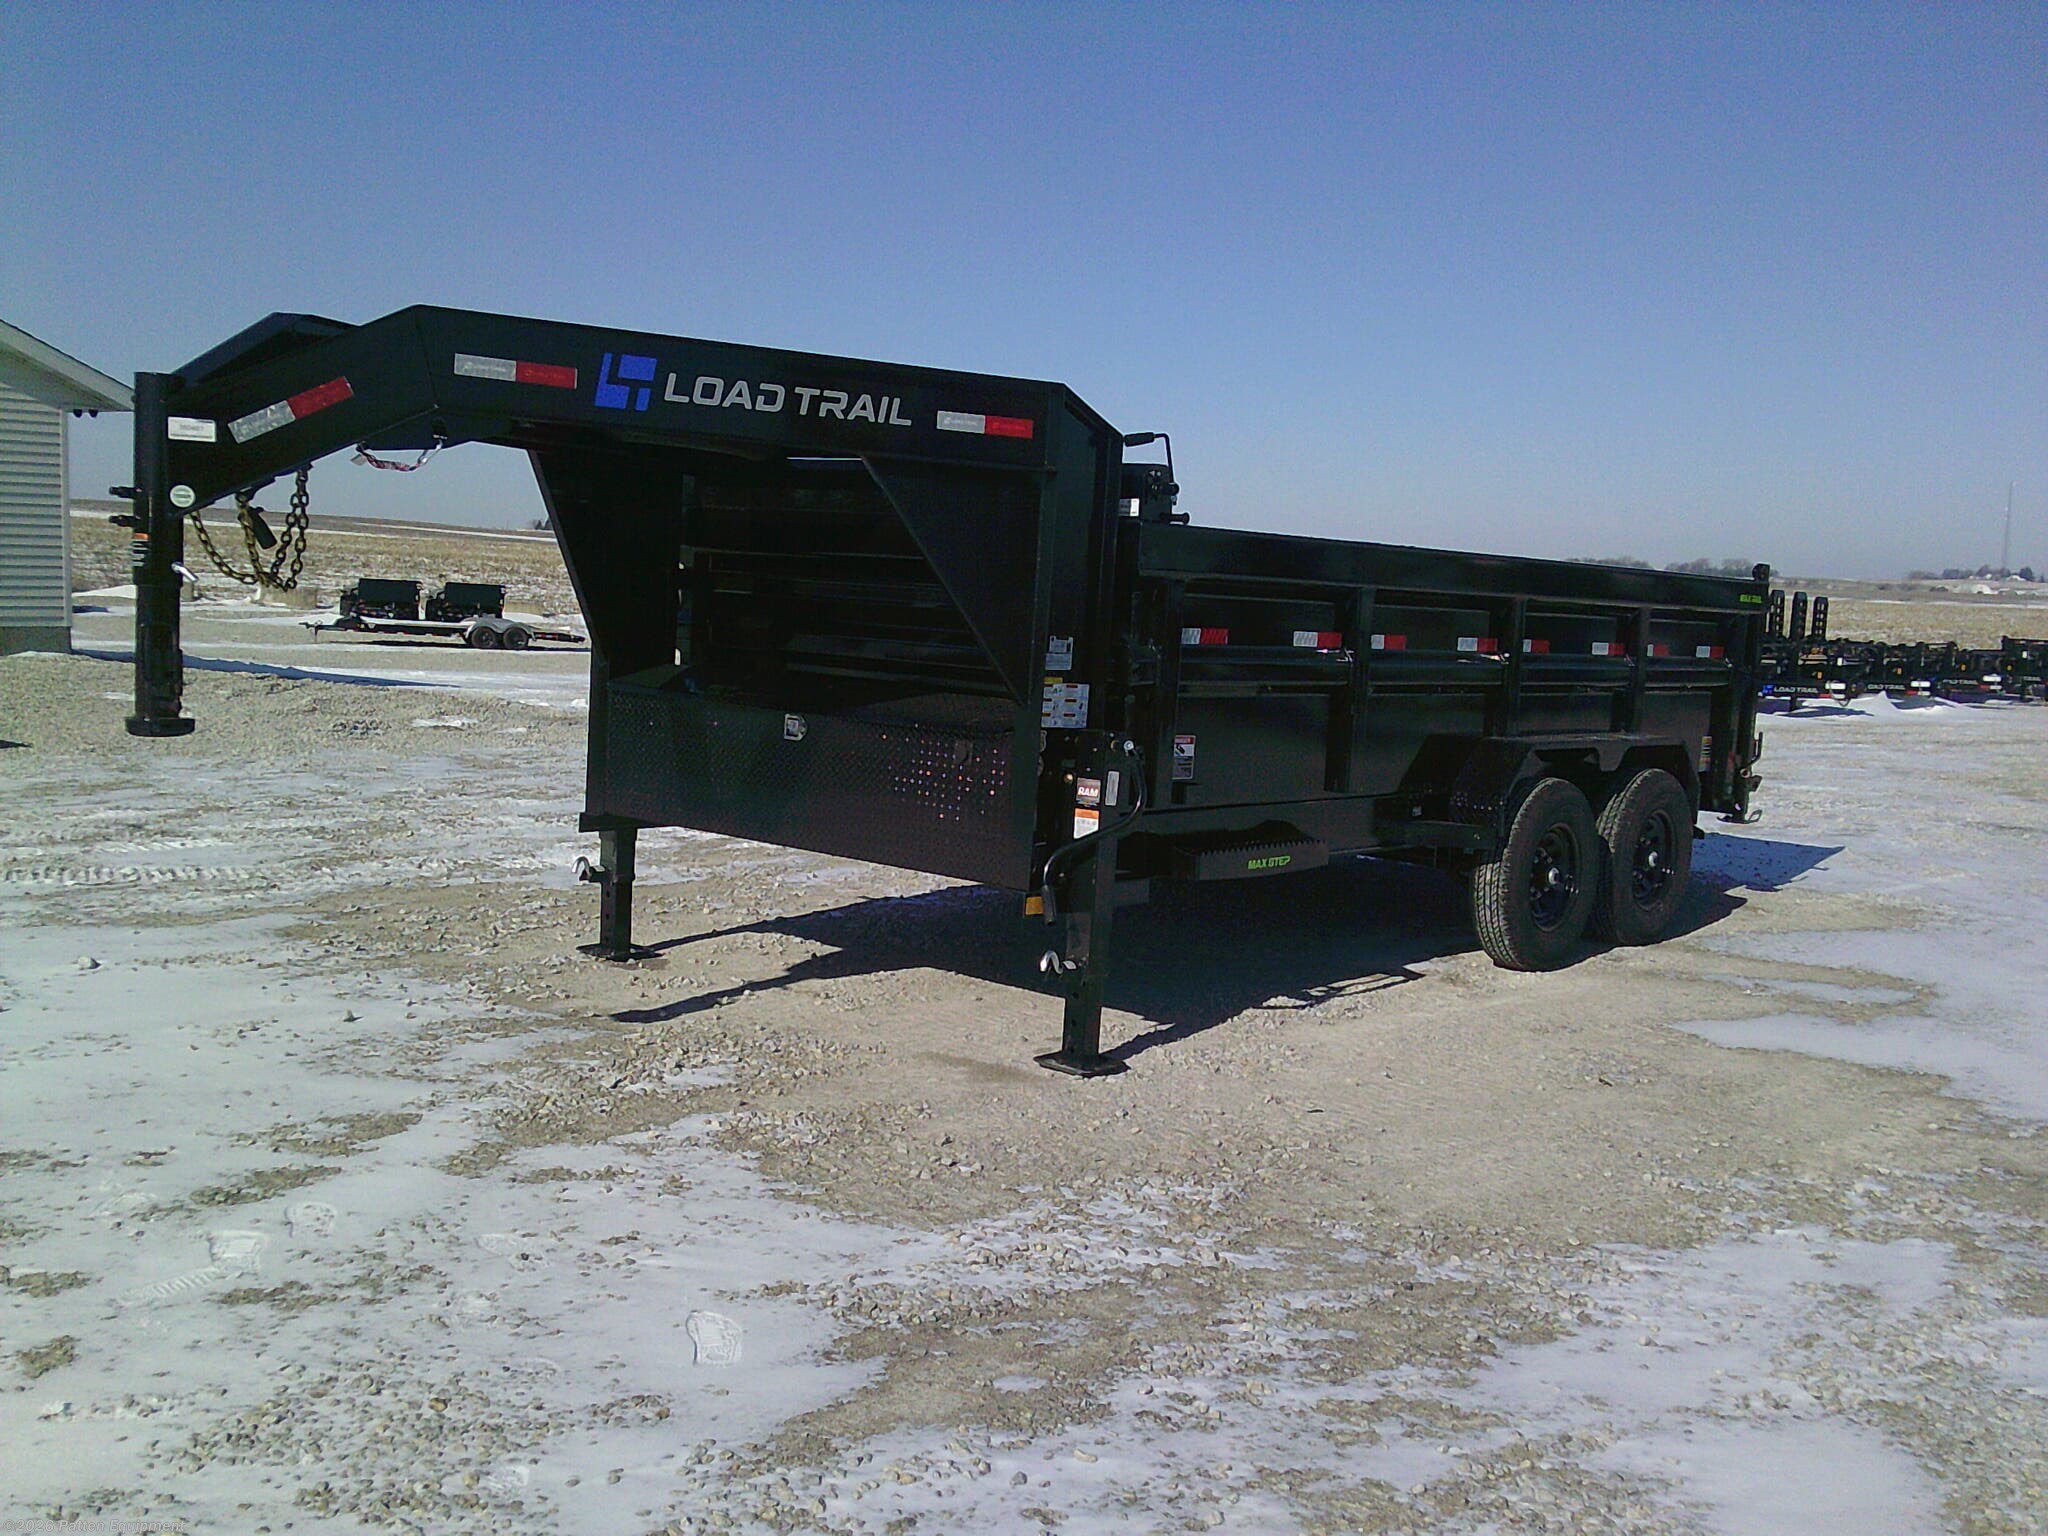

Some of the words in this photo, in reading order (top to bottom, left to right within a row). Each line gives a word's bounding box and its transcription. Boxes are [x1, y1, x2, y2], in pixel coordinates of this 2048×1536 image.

[664, 372, 785, 413] LOAD
[795, 387, 912, 426] TRAIL
[1077, 786, 1099, 798] RAM
[1247, 858, 1267, 870] MAX
